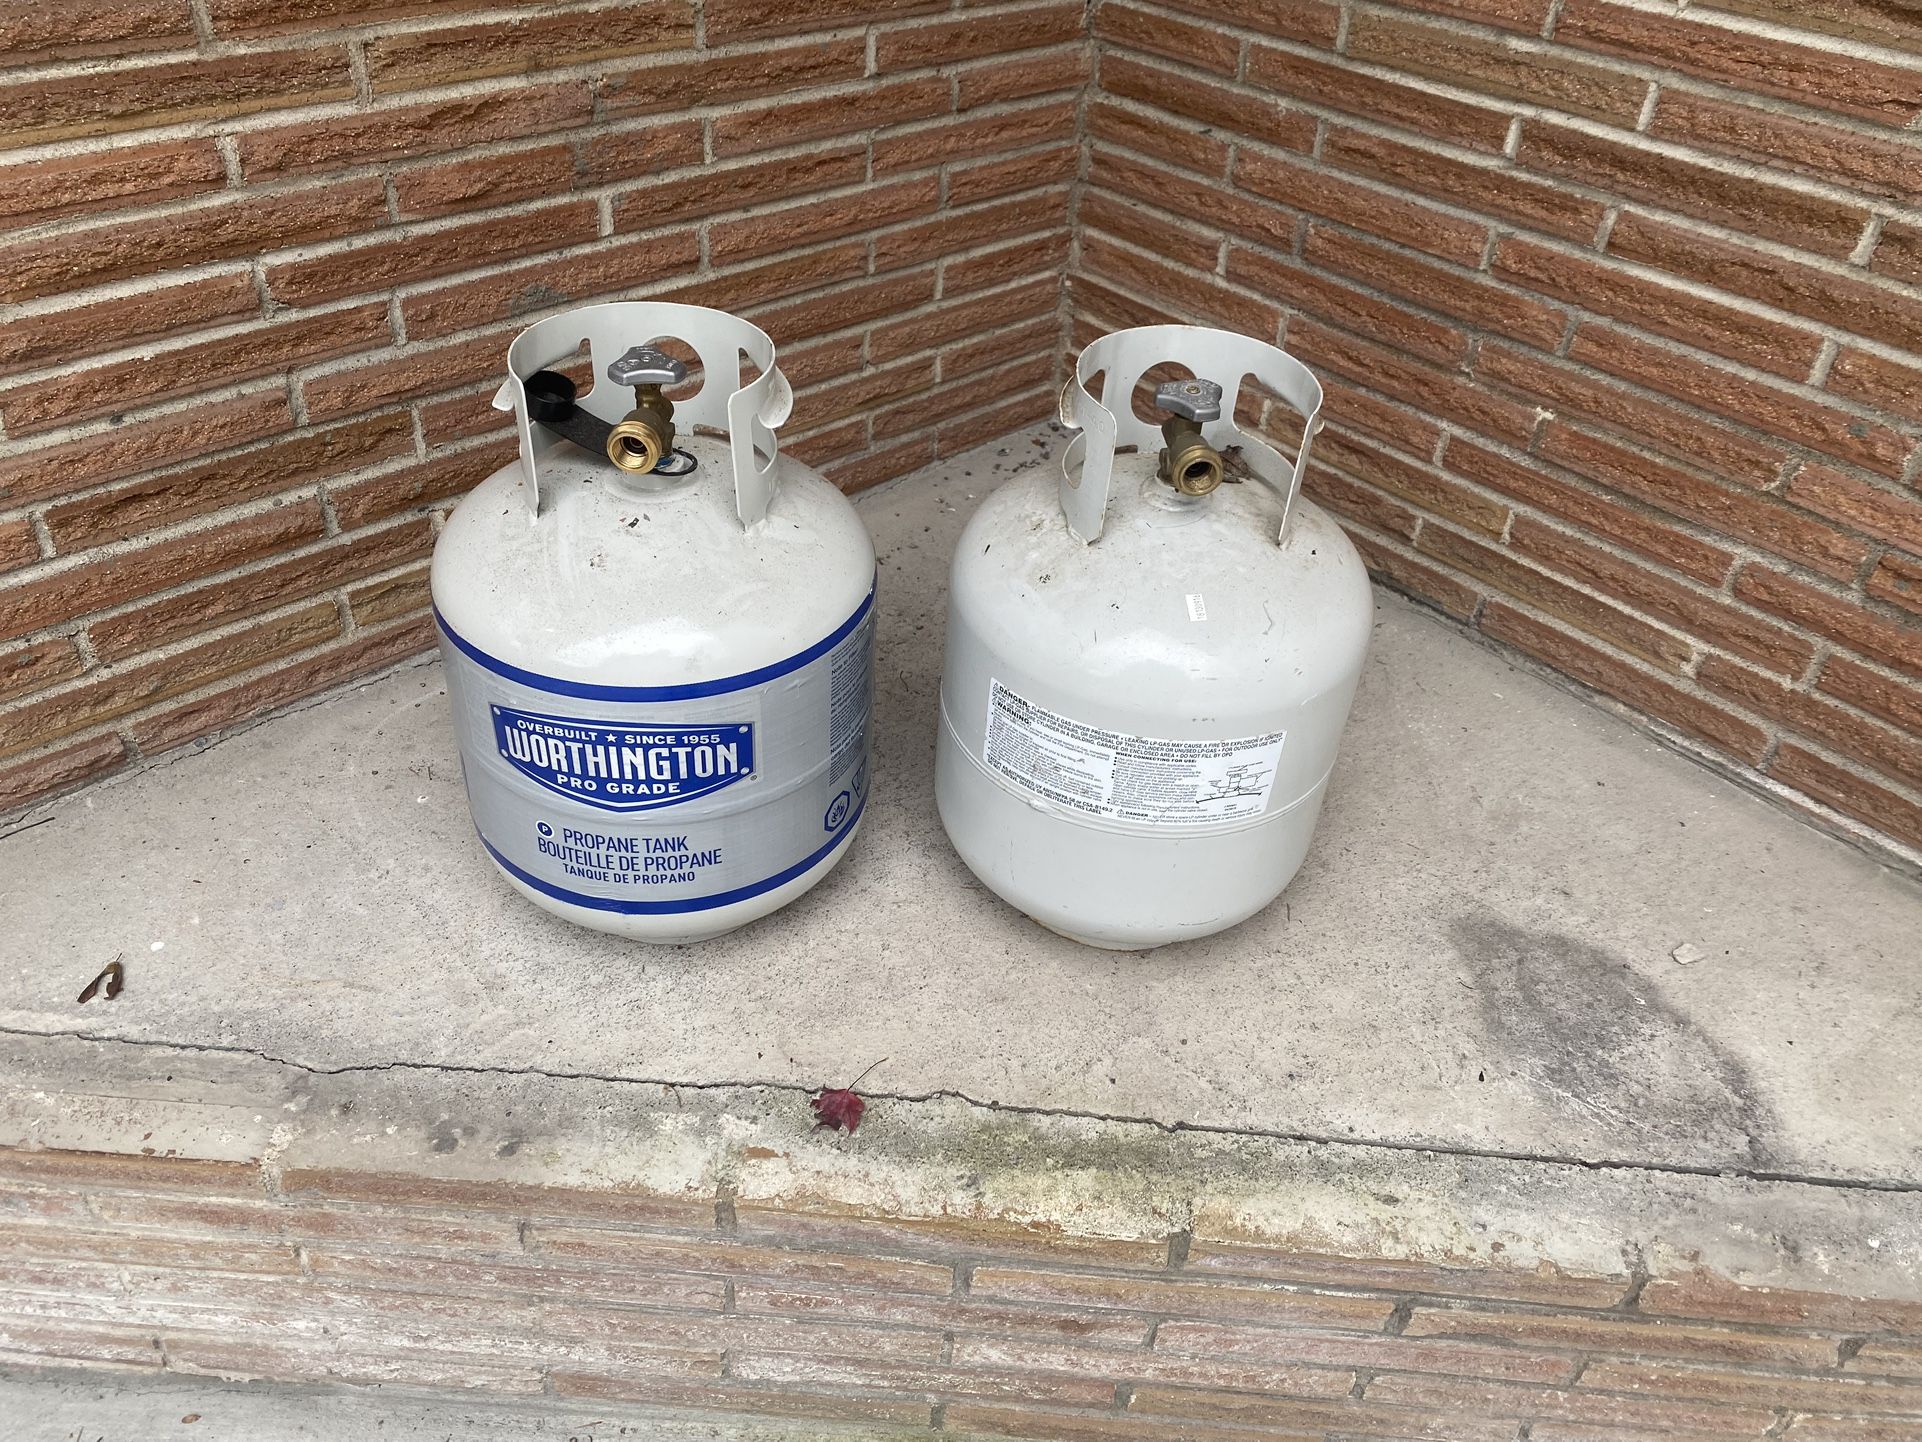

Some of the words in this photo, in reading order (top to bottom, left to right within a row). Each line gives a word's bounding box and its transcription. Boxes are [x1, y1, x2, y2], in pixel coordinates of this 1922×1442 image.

[997, 700, 1032, 726] WARNING:
[1032, 706, 1060, 722] FLAMMABLE
[1060, 718, 1072, 727] GAS
[1072, 722, 1090, 733] UNDER
[1091, 728, 1120, 740] PRESSURE
[1124, 737, 1149, 746] LEAKING
[1230, 738, 1258, 746] EXPLOSION
[517, 720, 598, 741] OVERBUILT
[624, 734, 677, 745] SINCE
[682, 734, 721, 744] 1955
[1036, 719, 1060, 733] CYLINDER
[1096, 741, 1120, 751] GARAGE
[1130, 748, 1160, 757] ENCLOSED
[1047, 718, 1058, 726] FOR
[1088, 732, 1115, 745] DISPOSAL
[1137, 744, 1165, 752] CYLINDER
[1234, 743, 1259, 752] OUTDOOR
[504, 725, 738, 780] WORTHINGTON
[1133, 754, 1170, 763] CONNECTING
[556, 773, 598, 791] PRO
[606, 782, 681, 795] GRADE
[1044, 792, 1073, 807] OBLITERATE
[1074, 802, 1085, 811] THIS
[1086, 806, 1102, 815] LABEL
[537, 836, 616, 870] BOUTEILLE
[618, 856, 640, 872] DE
[644, 848, 723, 872] PROPANE
[562, 828, 640, 854] PROPANE
[642, 836, 689, 854] TANK
[562, 863, 610, 882] TANQUE
[613, 872, 630, 884] DE
[634, 871, 696, 885] PROPANO
